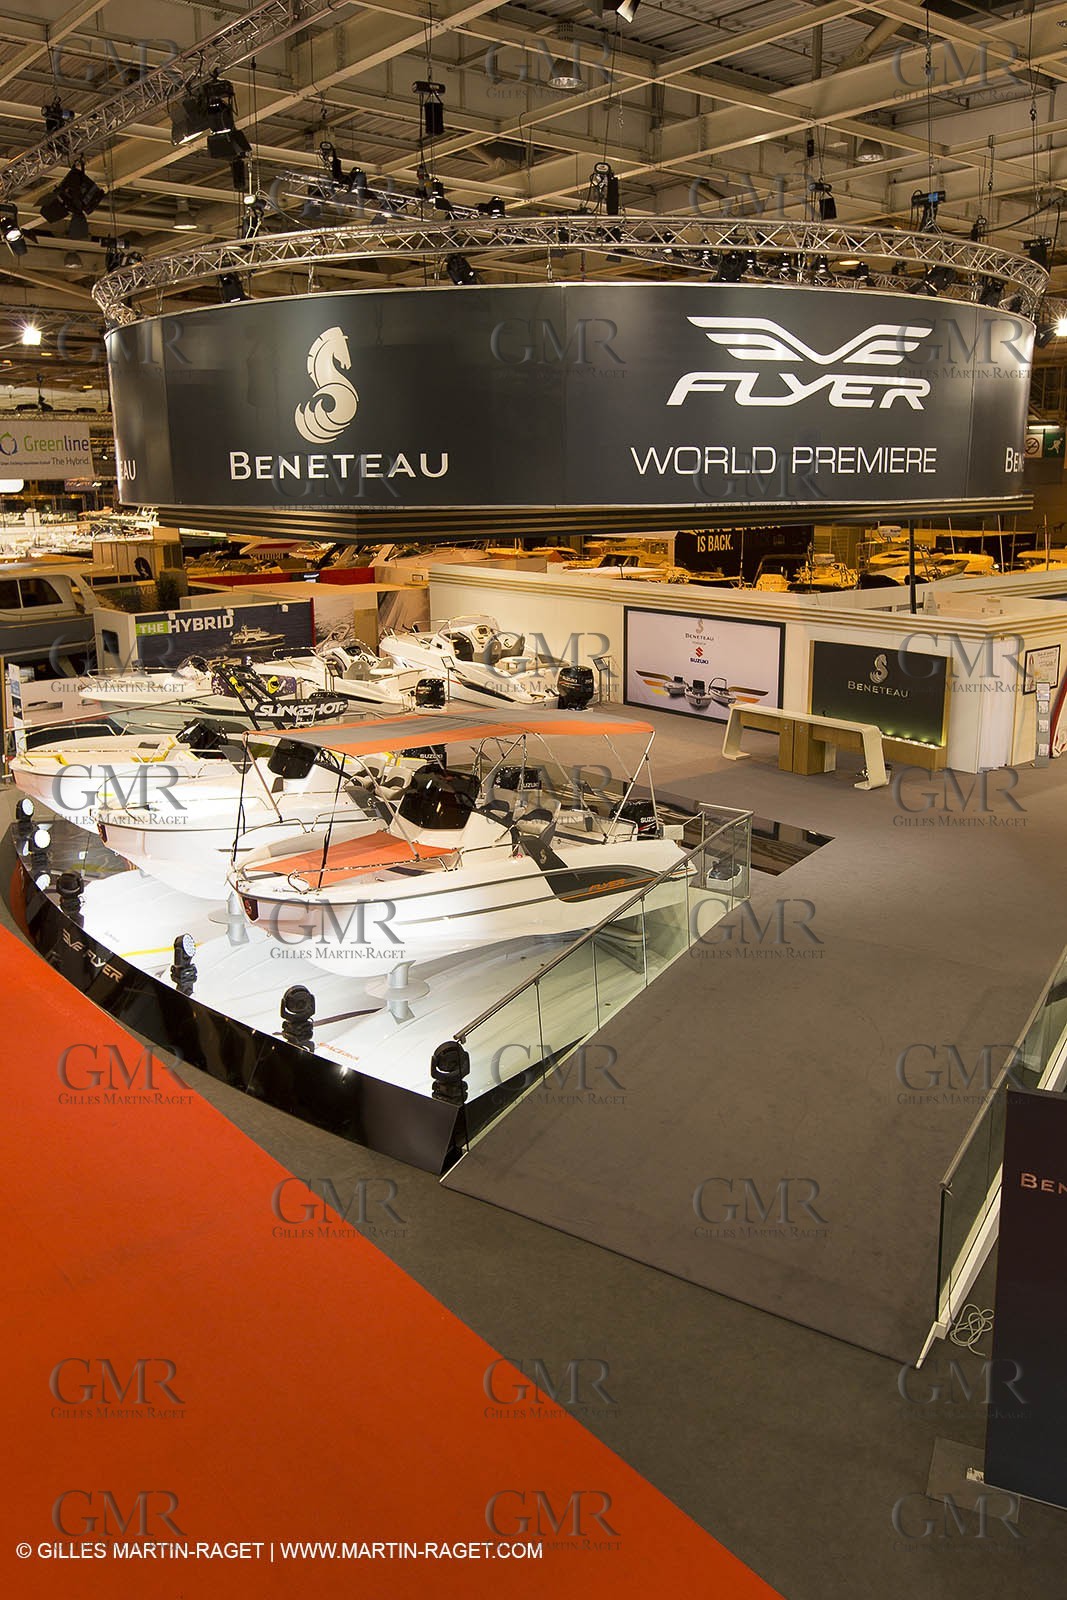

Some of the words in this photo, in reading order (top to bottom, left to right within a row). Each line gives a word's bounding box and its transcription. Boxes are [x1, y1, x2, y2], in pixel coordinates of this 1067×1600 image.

[666, 371, 931, 410] FLYER
[23, 435, 89, 451] Greenline
[52, 456, 65, 465] The
[229, 451, 449, 480] BENETEAU
[630, 446, 776, 475] WORLD
[792, 446, 937, 474] PREMIERE
[697, 536, 706, 552] IS
[707, 534, 734, 550] BACK.
[138, 622, 165, 634] THE
[167, 614, 235, 634] HYBRID
[847, 680, 909, 698] BENETEAU
